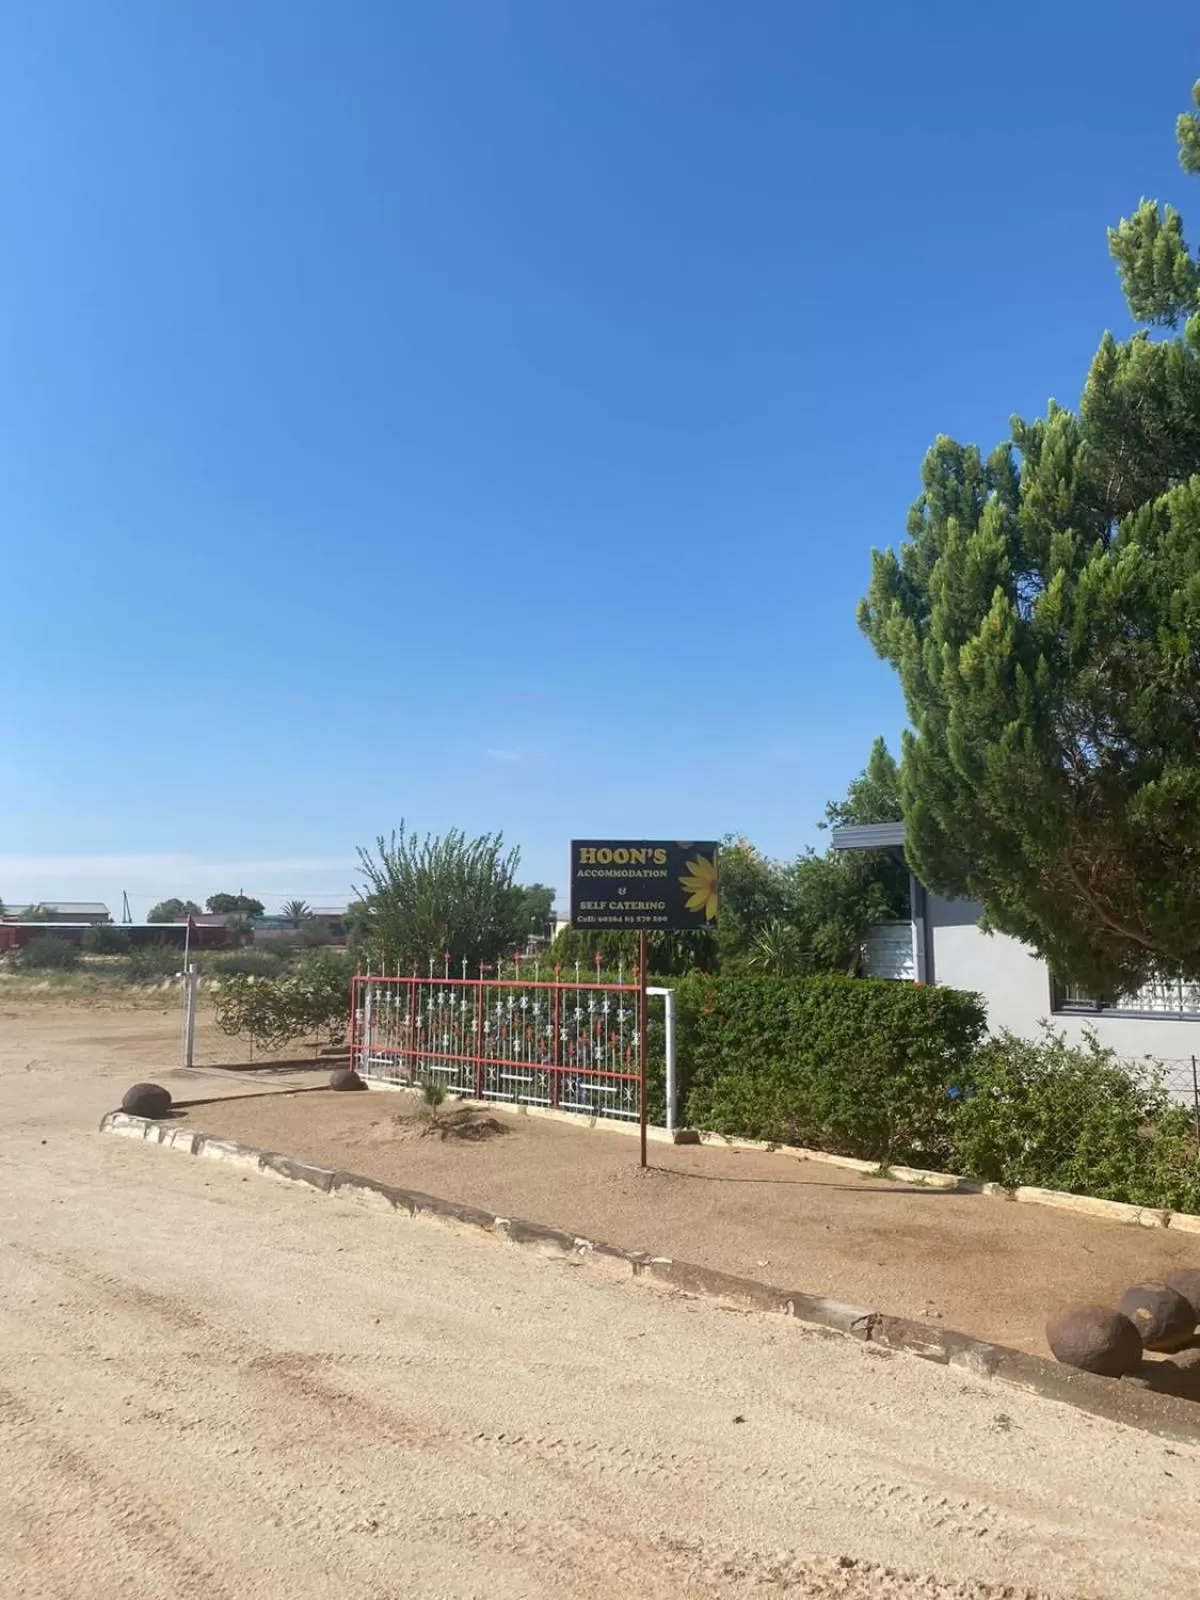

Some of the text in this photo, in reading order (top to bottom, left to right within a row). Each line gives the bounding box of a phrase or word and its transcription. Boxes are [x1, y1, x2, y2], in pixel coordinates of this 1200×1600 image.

[579, 848, 667, 864] HOON'S
[577, 869, 667, 878] ACCOMMODATION
[580, 901, 666, 910] SELF CATERING
